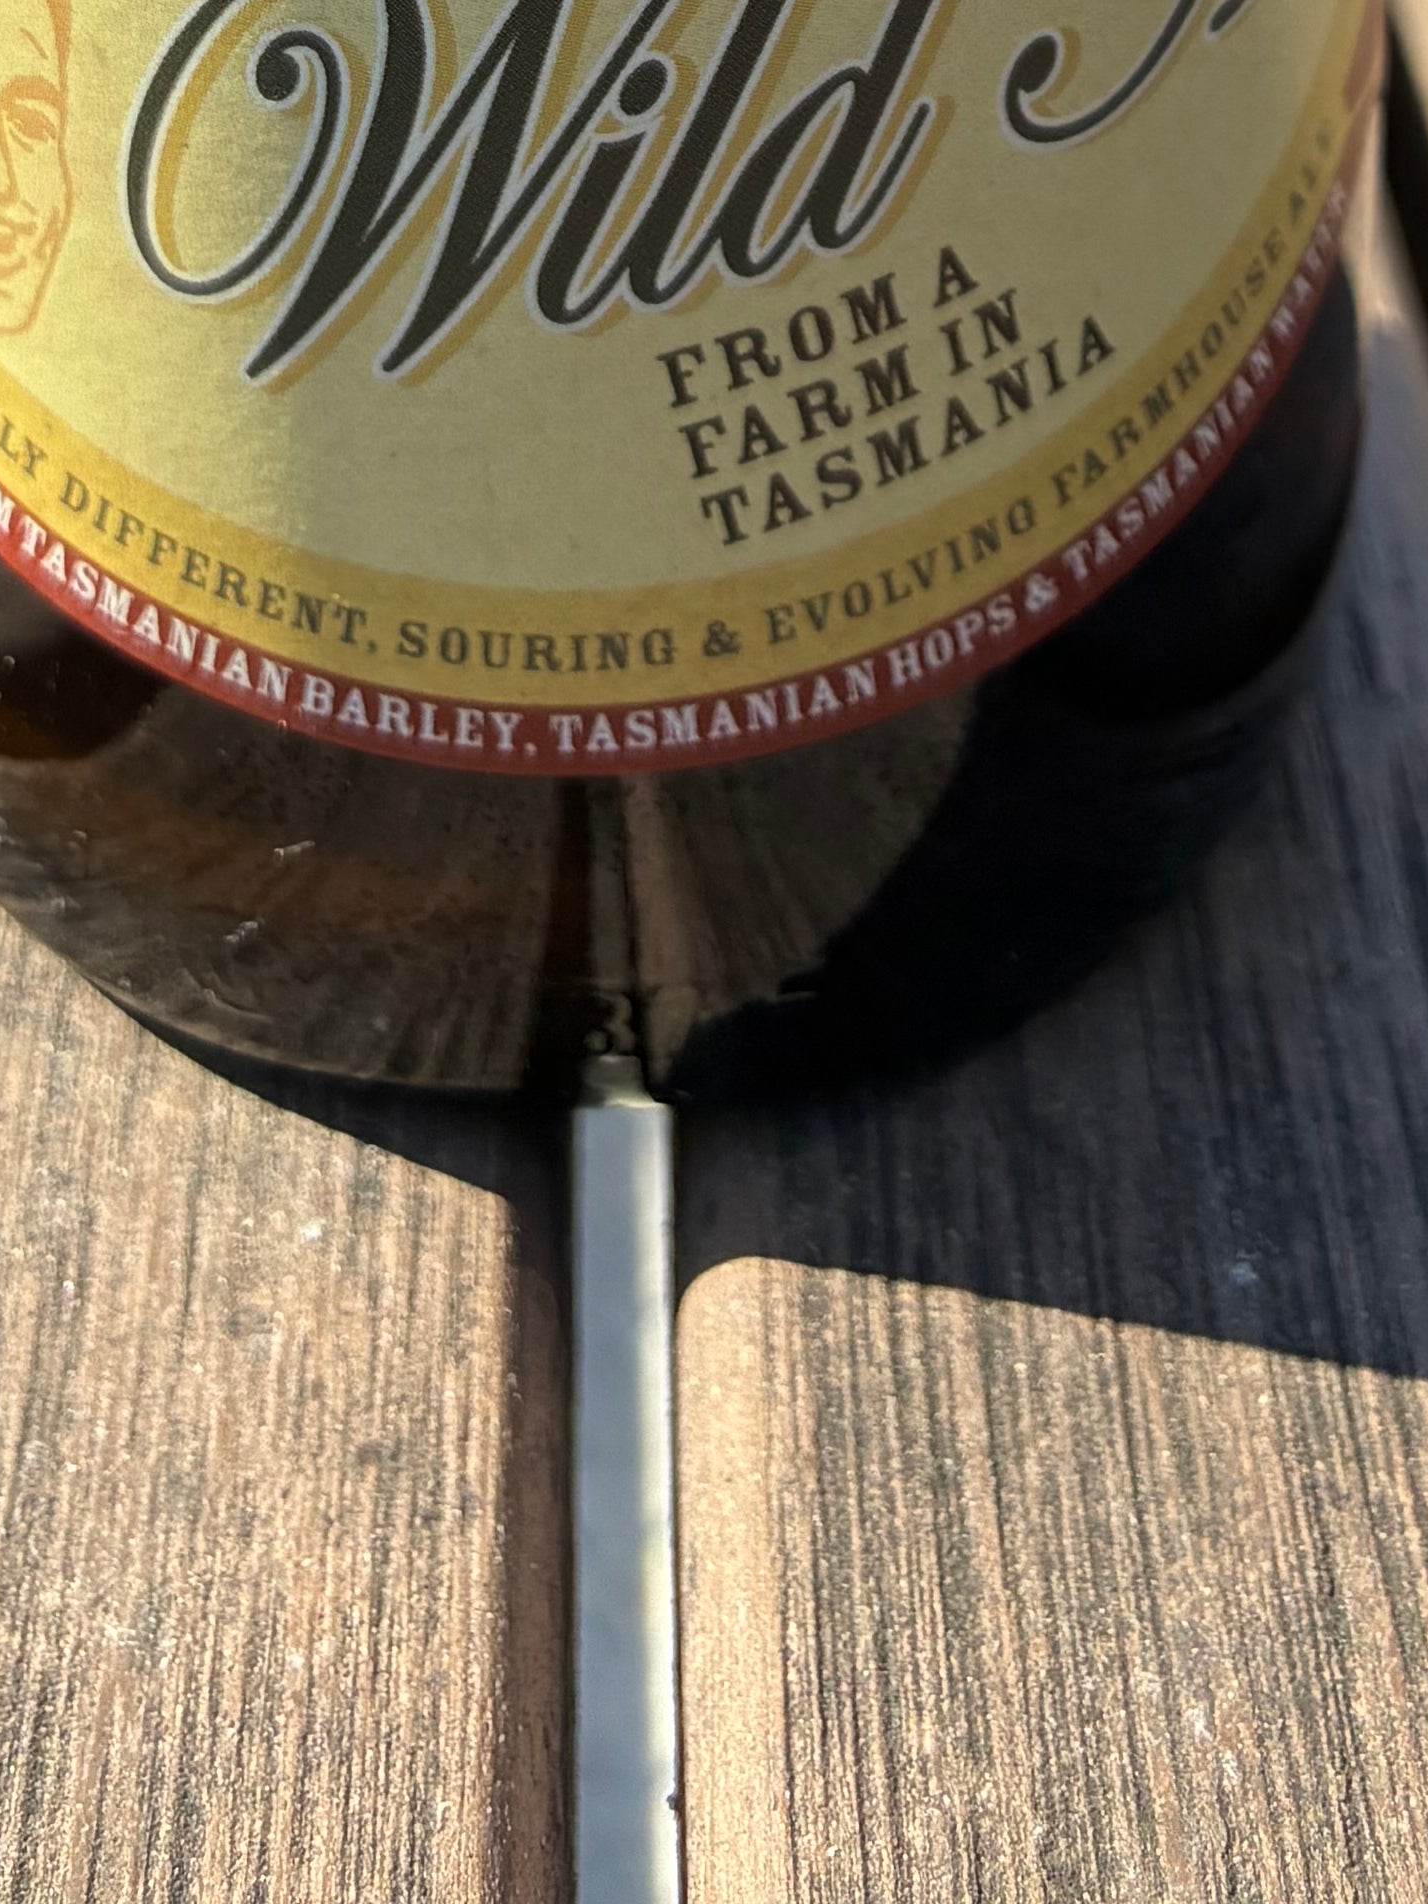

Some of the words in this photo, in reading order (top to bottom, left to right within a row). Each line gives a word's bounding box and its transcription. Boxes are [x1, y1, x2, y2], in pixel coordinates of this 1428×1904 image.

[656, 272, 907, 408] FROM
[933, 245, 979, 308] A
[679, 344, 921, 479] FARM
[939, 289, 1024, 375] IN
[701, 315, 1115, 546] TASMANIA
[10, 509, 294, 700] TASMANIAN
[549, 658, 878, 754] TASMANIAN
[887, 594, 1017, 687] HOPS
[1024, 572, 1060, 614] &
[1062, 339, 1272, 580] TASMANIAN
[397, 621, 676, 674] SOURING
[701, 619, 742, 658] &
[765, 497, 1036, 644] EVOLVING
[1050, 226, 1286, 509] FARMHOUSE
